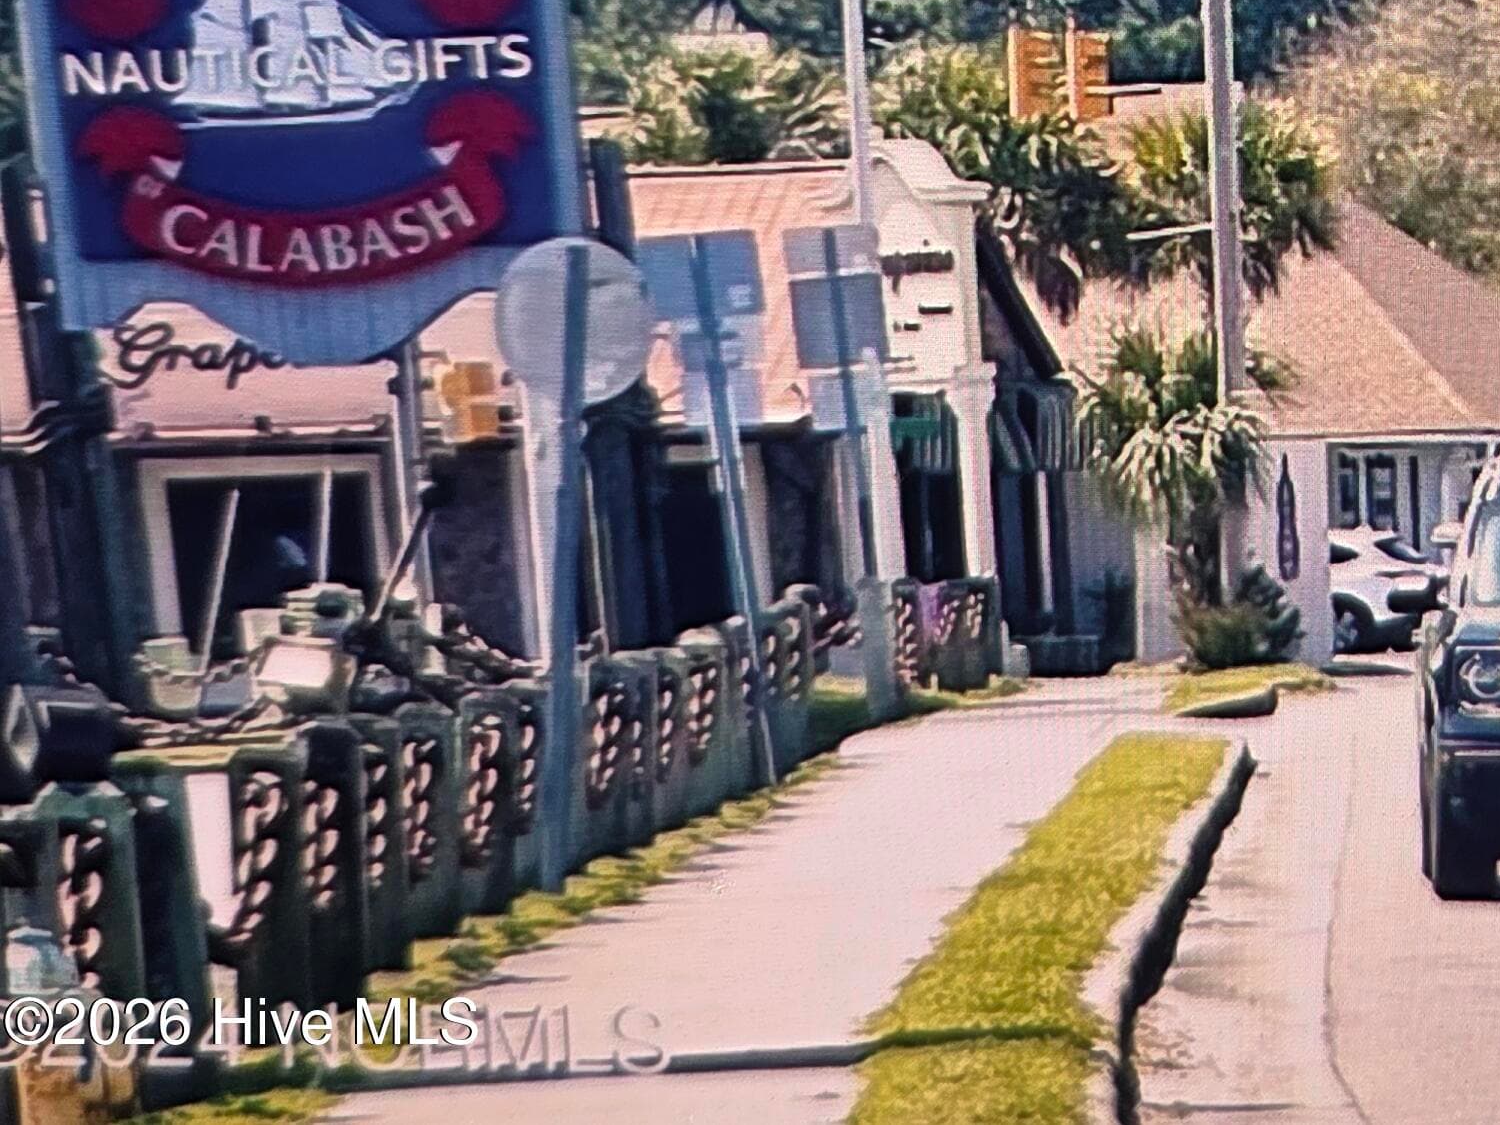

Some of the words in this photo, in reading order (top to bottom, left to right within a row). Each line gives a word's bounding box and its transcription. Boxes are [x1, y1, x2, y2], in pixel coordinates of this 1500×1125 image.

[60, 45, 355, 94] NAUTICAL
[380, 34, 533, 82] GIFTS
[160, 184, 476, 273] CALABASH
